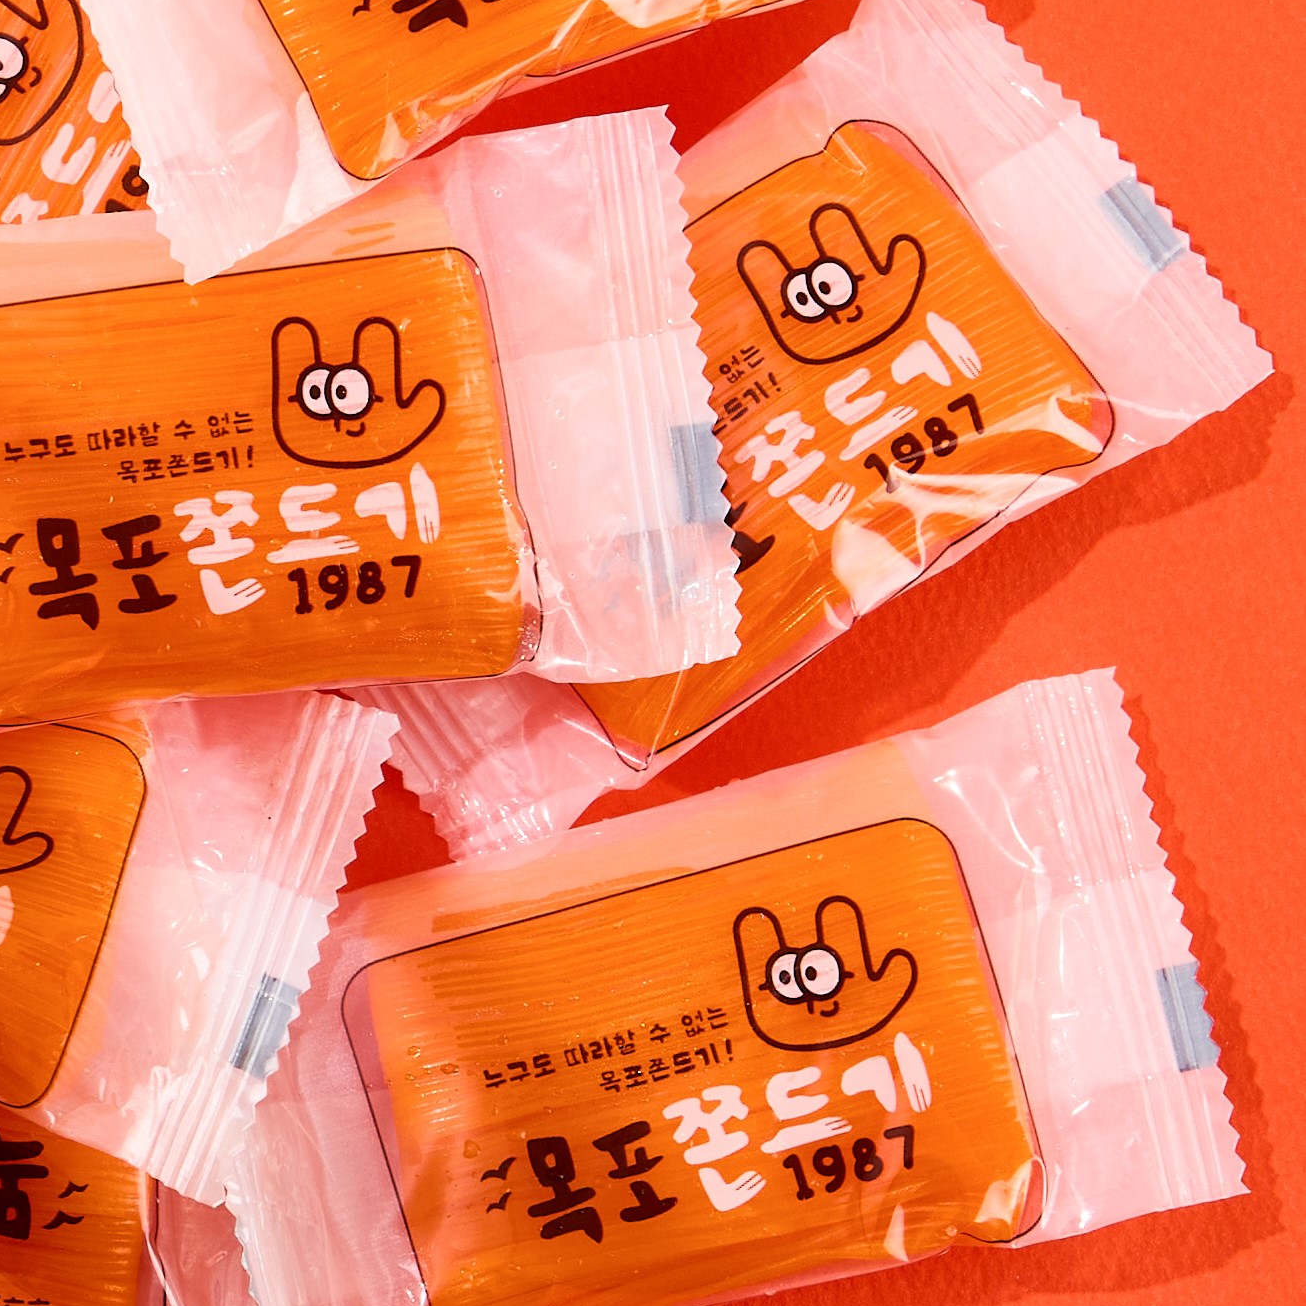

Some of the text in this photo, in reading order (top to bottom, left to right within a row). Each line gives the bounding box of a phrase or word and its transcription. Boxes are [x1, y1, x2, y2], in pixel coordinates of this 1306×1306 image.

[717, 343, 767, 385] 없는
[3, 410, 254, 465] 누구도 따라할 수 없는
[863, 393, 985, 494] 1987
[28, 461, 442, 631] 목포쫀드기
[287, 554, 422, 616] 1987
[481, 1005, 731, 1090] 누구도 따라할 수 없는
[525, 1031, 934, 1246] 목포쫀드기
[781, 1124, 916, 1201] 1987
